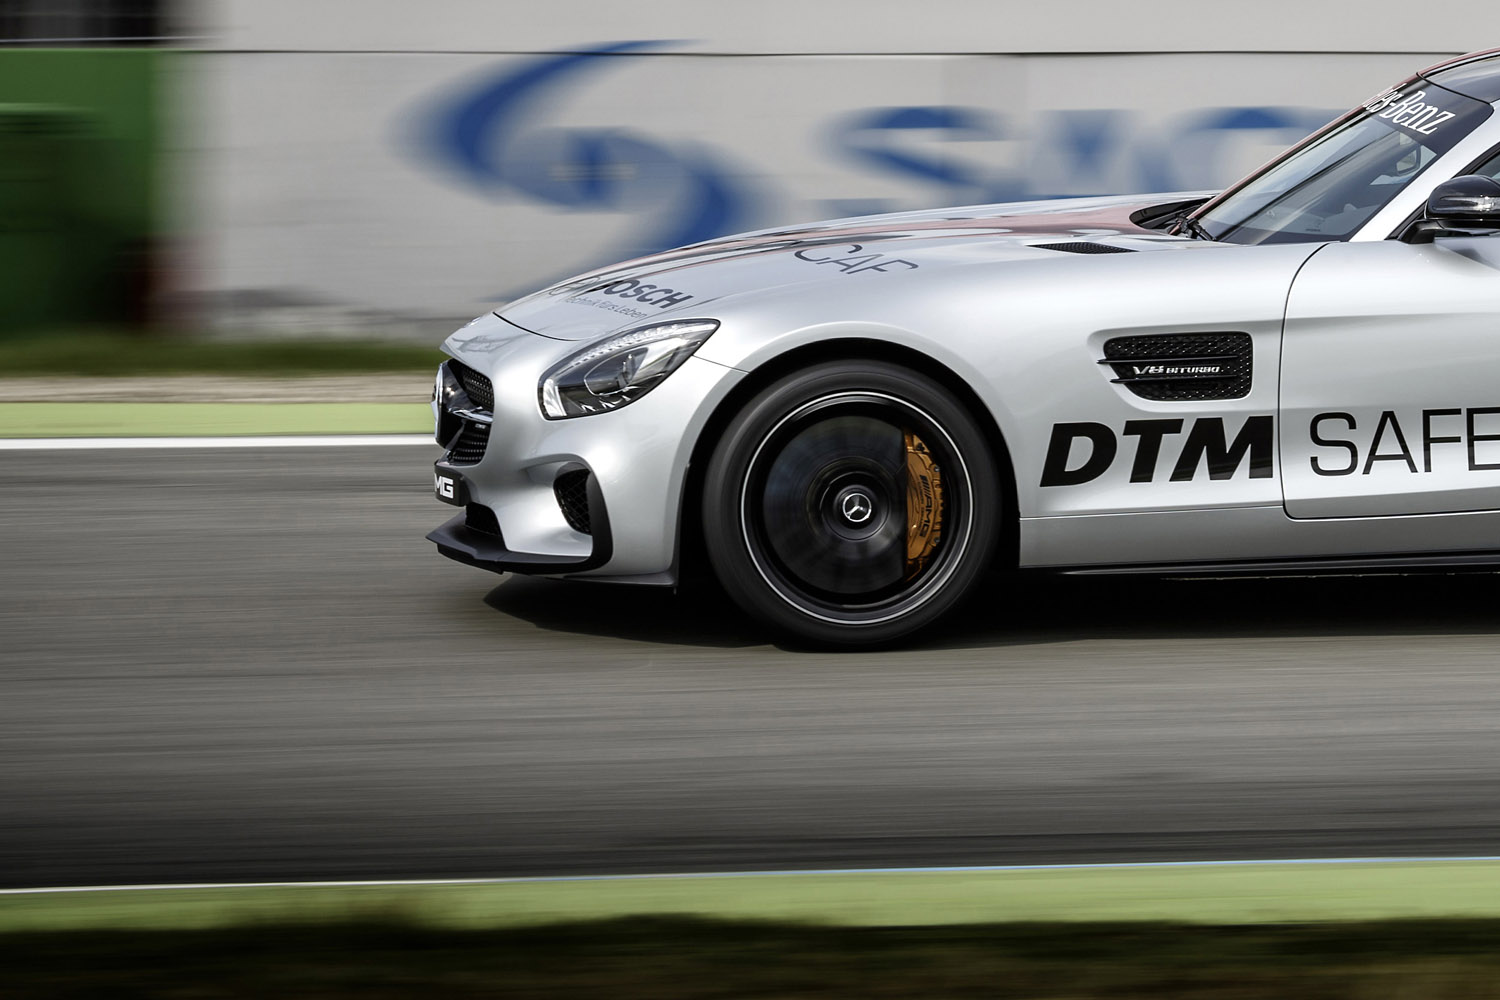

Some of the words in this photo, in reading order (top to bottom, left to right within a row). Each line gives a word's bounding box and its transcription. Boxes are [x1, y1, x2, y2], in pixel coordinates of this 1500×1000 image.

[1132, 365, 1164, 375] V8
[1165, 366, 1220, 374] BITURBO
[1039, 415, 1274, 488] DTM
